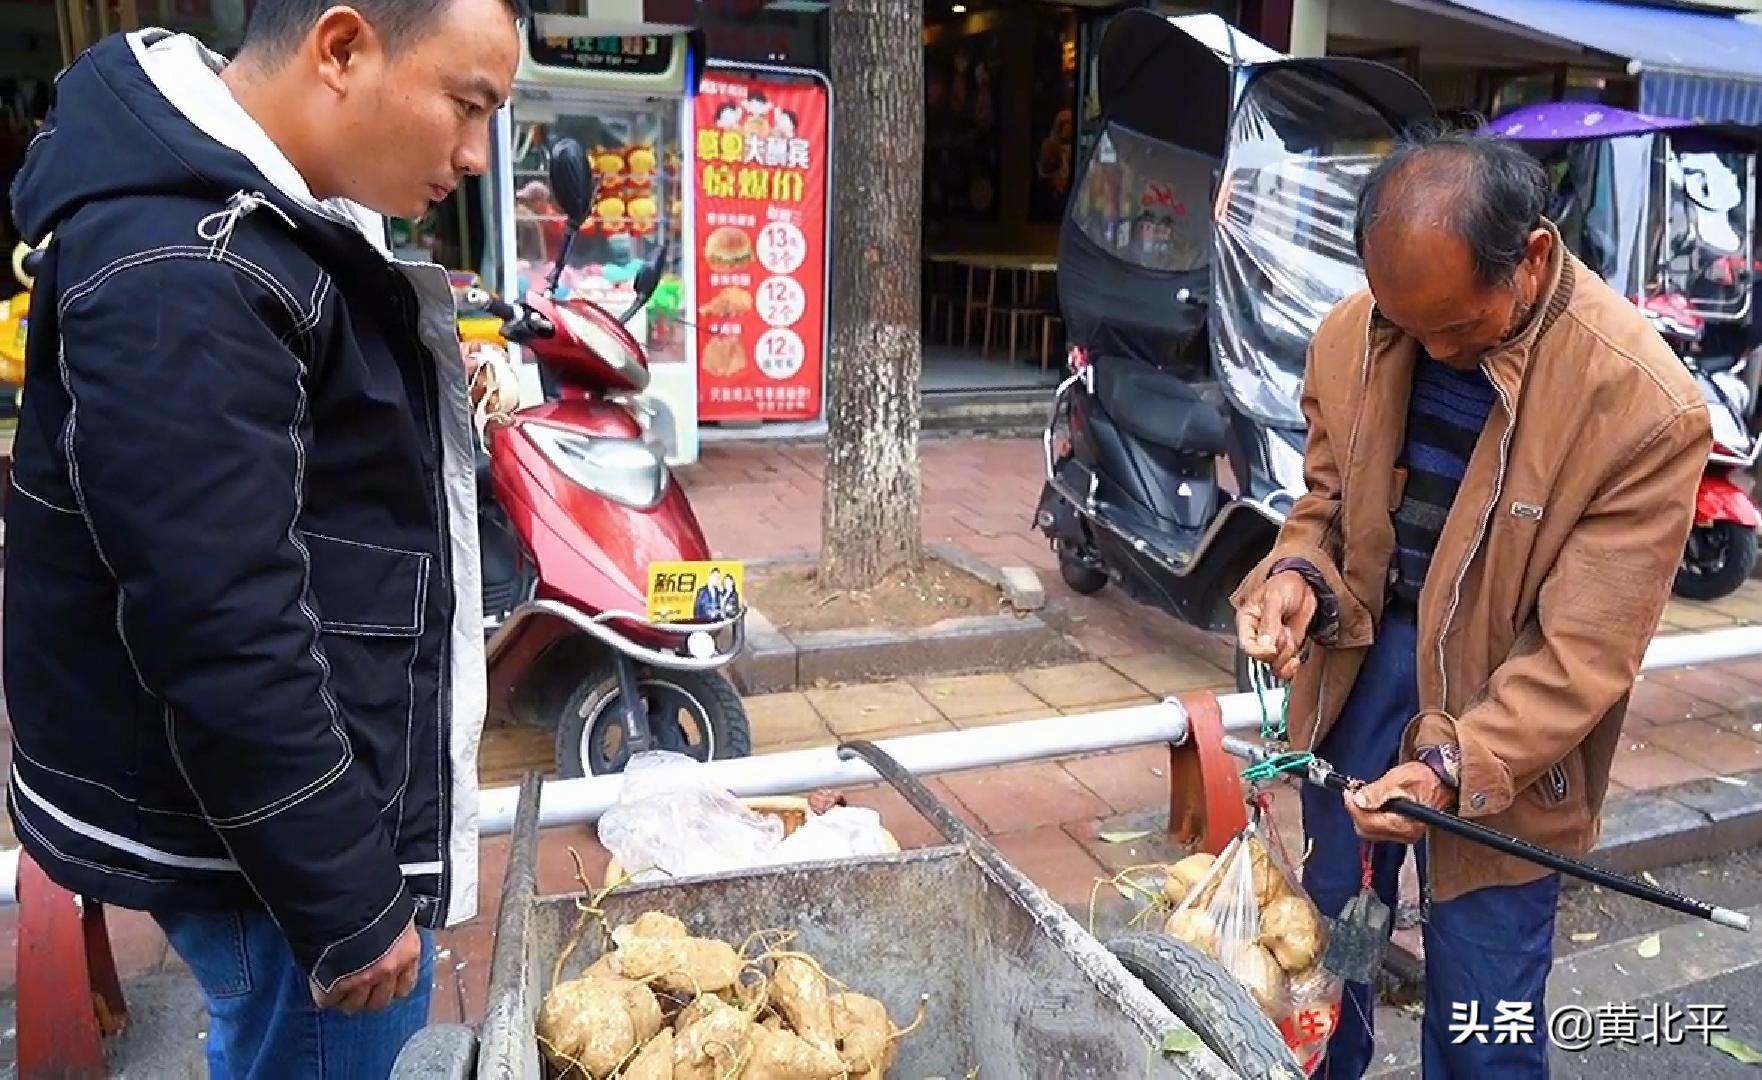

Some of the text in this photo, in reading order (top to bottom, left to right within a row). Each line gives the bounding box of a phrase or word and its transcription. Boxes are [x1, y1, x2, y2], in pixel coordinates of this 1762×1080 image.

[703, 165, 804, 202] 惊爆价
[654, 573, 697, 592] 新日
